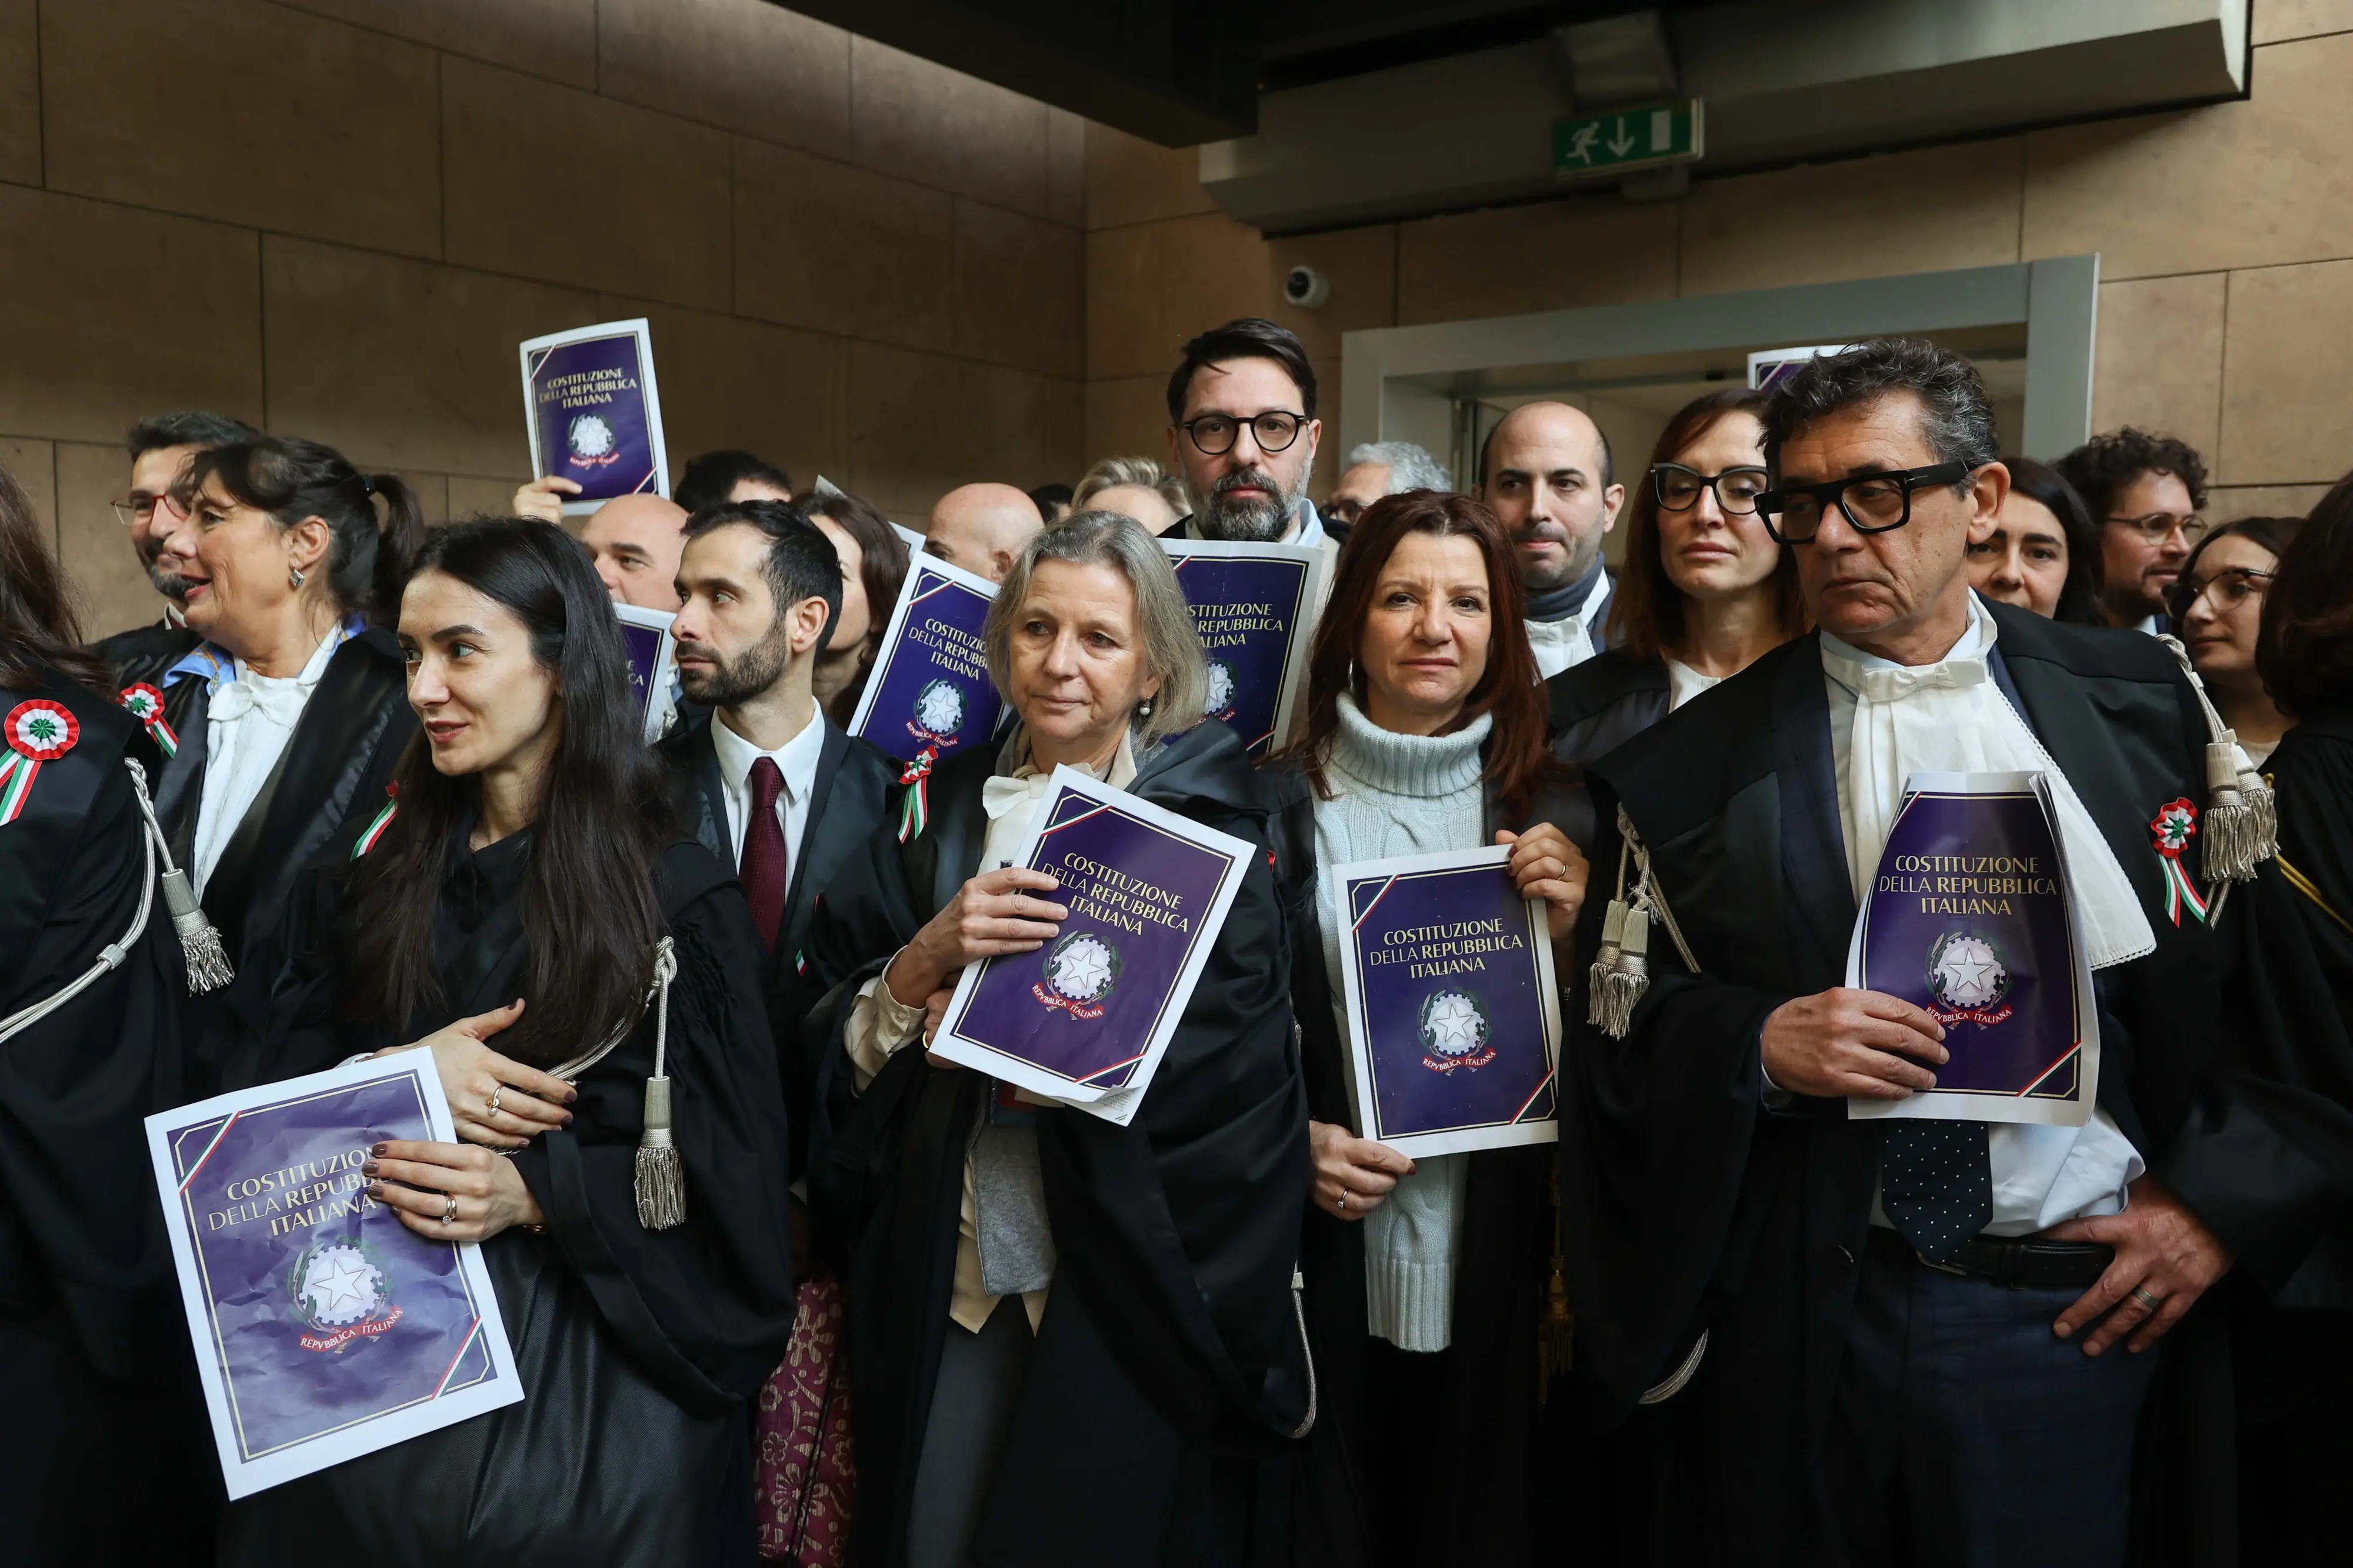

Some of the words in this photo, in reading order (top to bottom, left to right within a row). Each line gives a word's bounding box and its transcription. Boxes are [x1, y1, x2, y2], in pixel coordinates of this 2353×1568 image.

[539, 388, 569, 403] DELLA
[569, 378, 638, 396] REPUBBLICA
[548, 367, 624, 389] COSTITUZIONE
[562, 392, 612, 409] ITALIANA
[1187, 603, 1273, 618] STITUZIONE
[925, 618, 986, 653] COSTITUZIO
[1198, 618, 1283, 633] REPUBBLICA
[908, 626, 942, 650] DELLA
[944, 642, 988, 670] REPUBB
[1200, 633, 1247, 648] ALIANA
[931, 651, 979, 680] ITALIANA
[906, 722, 932, 739] REPVBBLICA
[934, 736, 958, 748] ITALIANA
[1895, 855, 2039, 873] COSTITUZIONE
[1064, 852, 1184, 910] COSTITUZIONE
[1879, 876, 1932, 893] DELLA
[1937, 876, 2057, 895] REPUBBLICA
[1069, 895, 1143, 936] ITALIANA
[1089, 883, 1188, 933] REPUBBLICA
[1921, 898, 2012, 915] ITALIANA
[1384, 918, 1504, 946] COSTITUZIONE
[1370, 947, 1418, 966] DELLA
[1421, 934, 1523, 959] REPUBBLICA
[1410, 956, 1486, 979] ITALIANA
[1032, 985, 1066, 1007] REPVBBLICA
[1070, 1004, 1103, 1019] ITALIANA
[1925, 1006, 1969, 1022] REPVBBLICA
[1974, 1009, 2012, 1023] ITALIANA
[1422, 1059, 1461, 1070] REPVBBLICA
[1465, 1051, 1496, 1066] ITALIANA
[227, 1146, 372, 1201] COSTITUZIO
[208, 1196, 281, 1231] DELLA
[285, 1170, 388, 1209] REPUBB
[270, 1193, 377, 1236] ITALIANA
[300, 1330, 356, 1350] REPVBBLICA
[362, 1309, 404, 1334] ITALIANA
